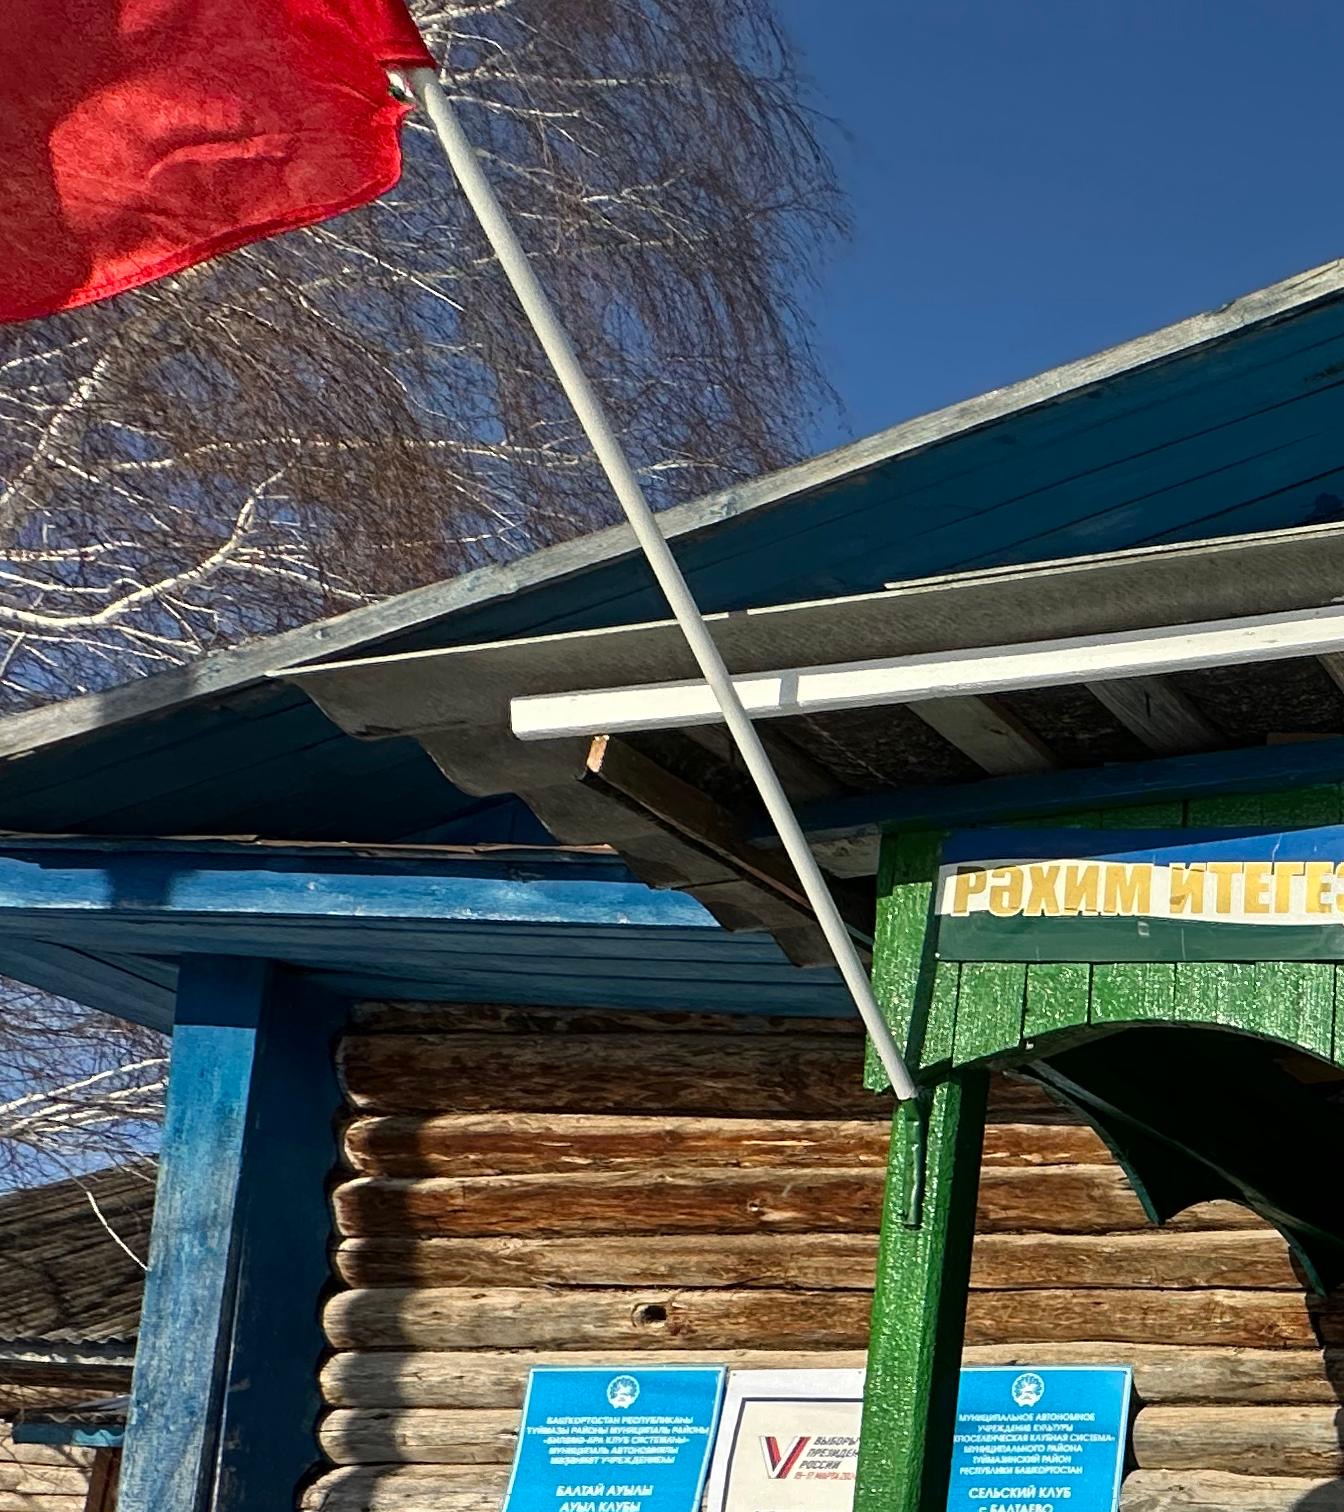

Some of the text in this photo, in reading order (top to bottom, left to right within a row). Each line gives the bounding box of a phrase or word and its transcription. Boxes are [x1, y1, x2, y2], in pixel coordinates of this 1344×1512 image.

[951, 864, 1153, 915] РӘХИМ
[806, 1448, 859, 1458] ПРЕЗИДЕН
[799, 1460, 841, 1469] РОССИИ
[556, 1483, 604, 1496] БАЛТАЙ
[968, 1485, 1071, 1499] СЕЛЬСКИЙ КЛУБ
[559, 1502, 641, 1512] АУЫЛ КЛУБЫ
